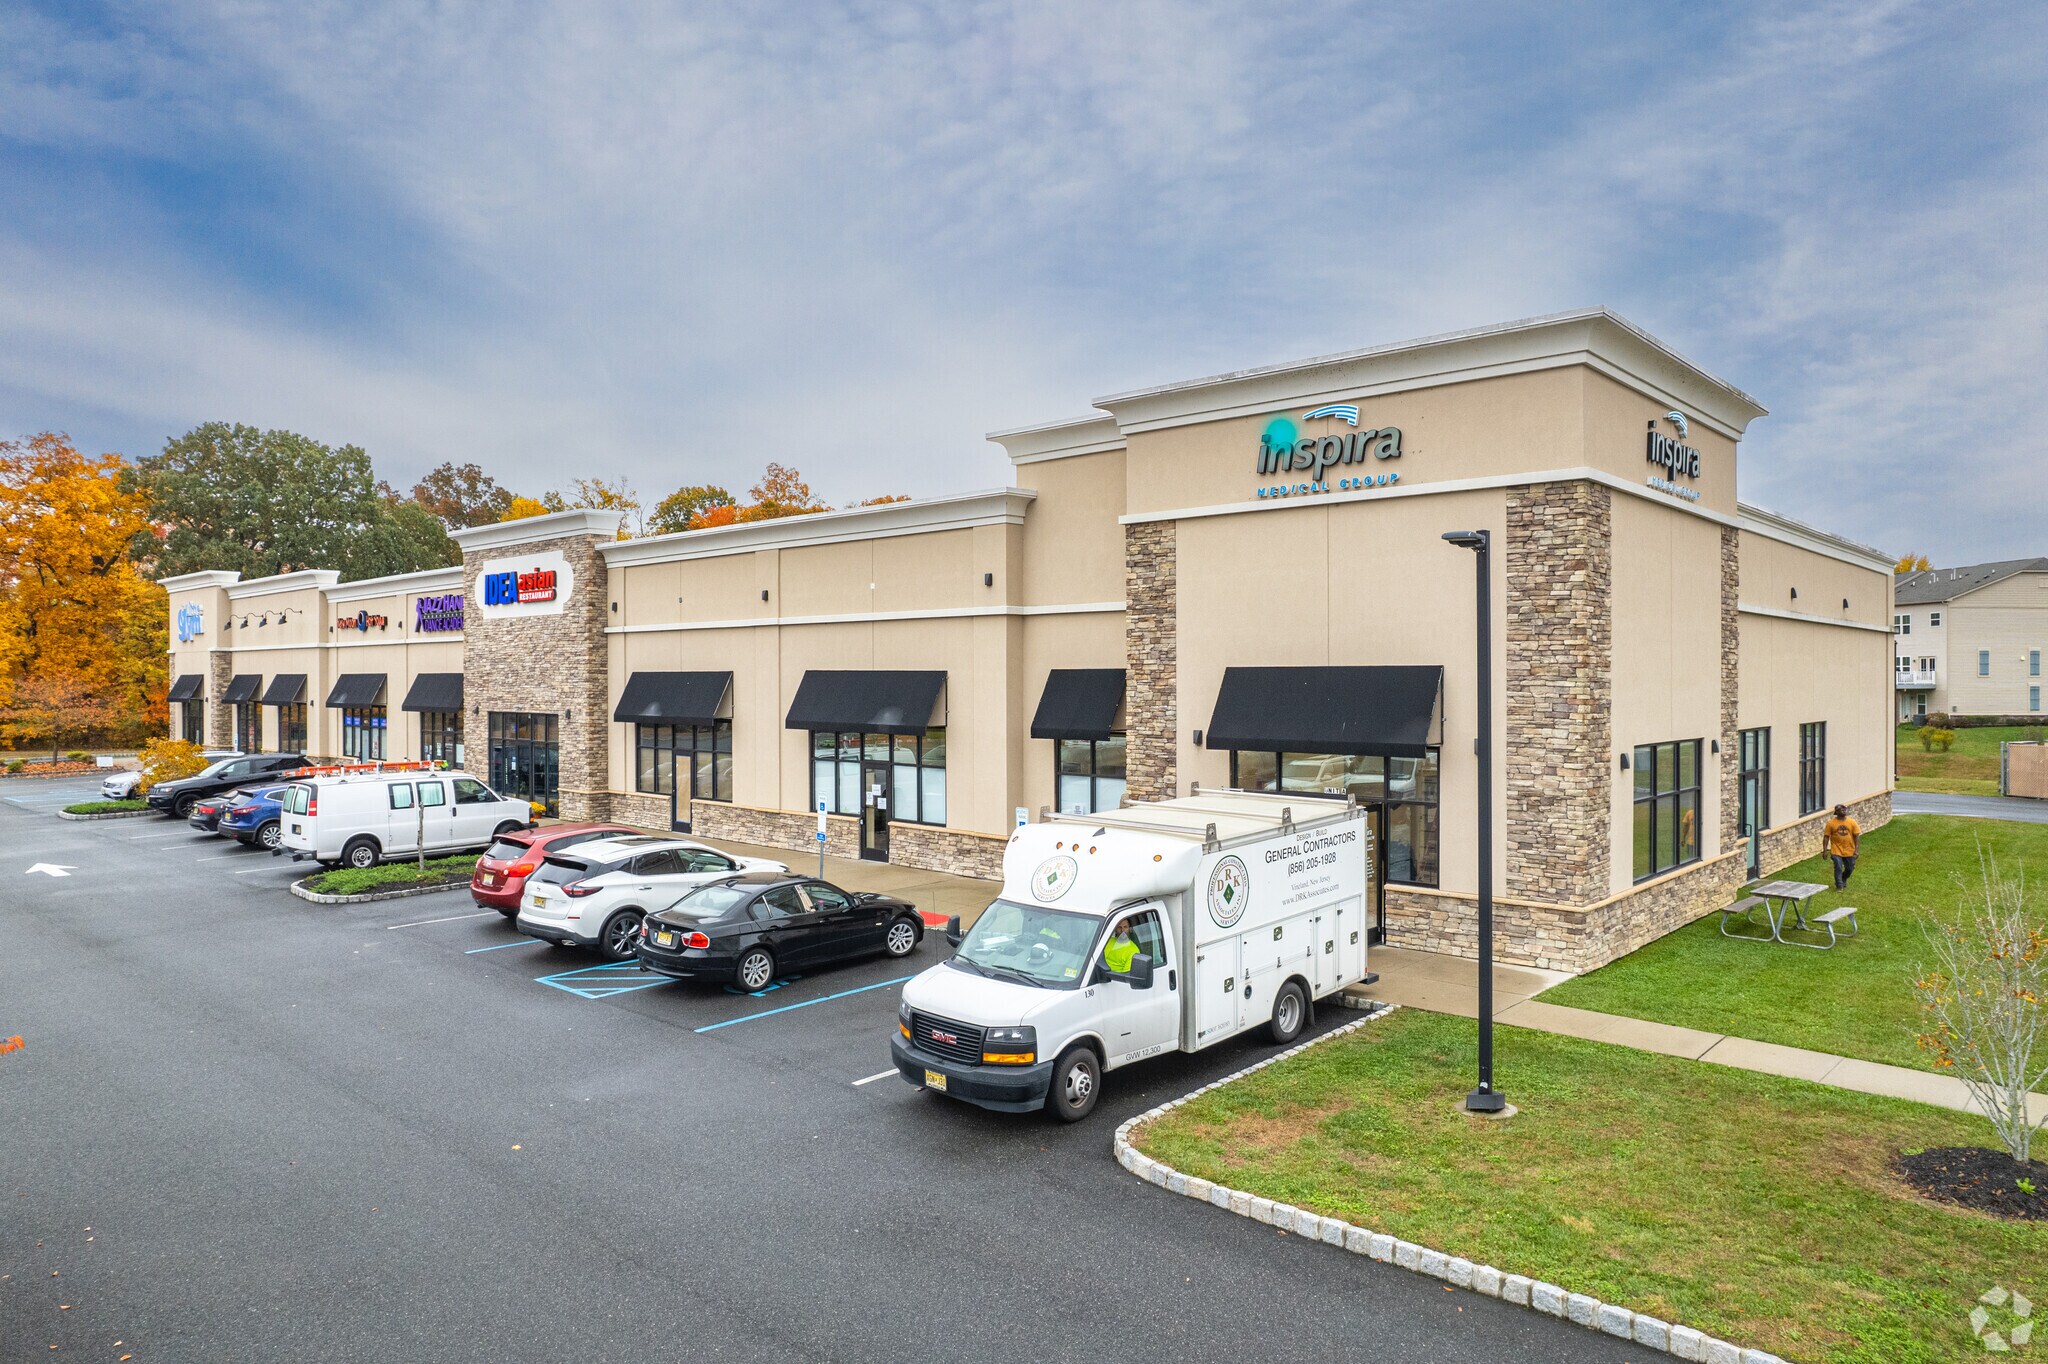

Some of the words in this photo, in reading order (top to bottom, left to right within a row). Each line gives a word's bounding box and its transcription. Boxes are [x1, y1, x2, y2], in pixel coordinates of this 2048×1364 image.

[1257, 427, 1402, 481] inspira
[1647, 420, 1700, 481] inspira
[1257, 481, 1330, 497] MEDICAL
[1339, 473, 1400, 489] GROUP
[485, 571, 518, 606] IDEA
[518, 567, 557, 591] asian
[519, 590, 553, 601] RESTAURANT
[423, 597, 443, 613] JAZZ
[424, 618, 443, 632] DANCE
[1265, 845, 1302, 864] GENERAL
[1303, 831, 1356, 854] CONTRACTORS
[1288, 860, 1305, 877] (856)
[1306, 852, 1337, 870] 205-1928
[1084, 988, 1095, 999] 130
[931, 1029, 957, 1046] GMC
[1125, 1051, 1142, 1062] GVW
